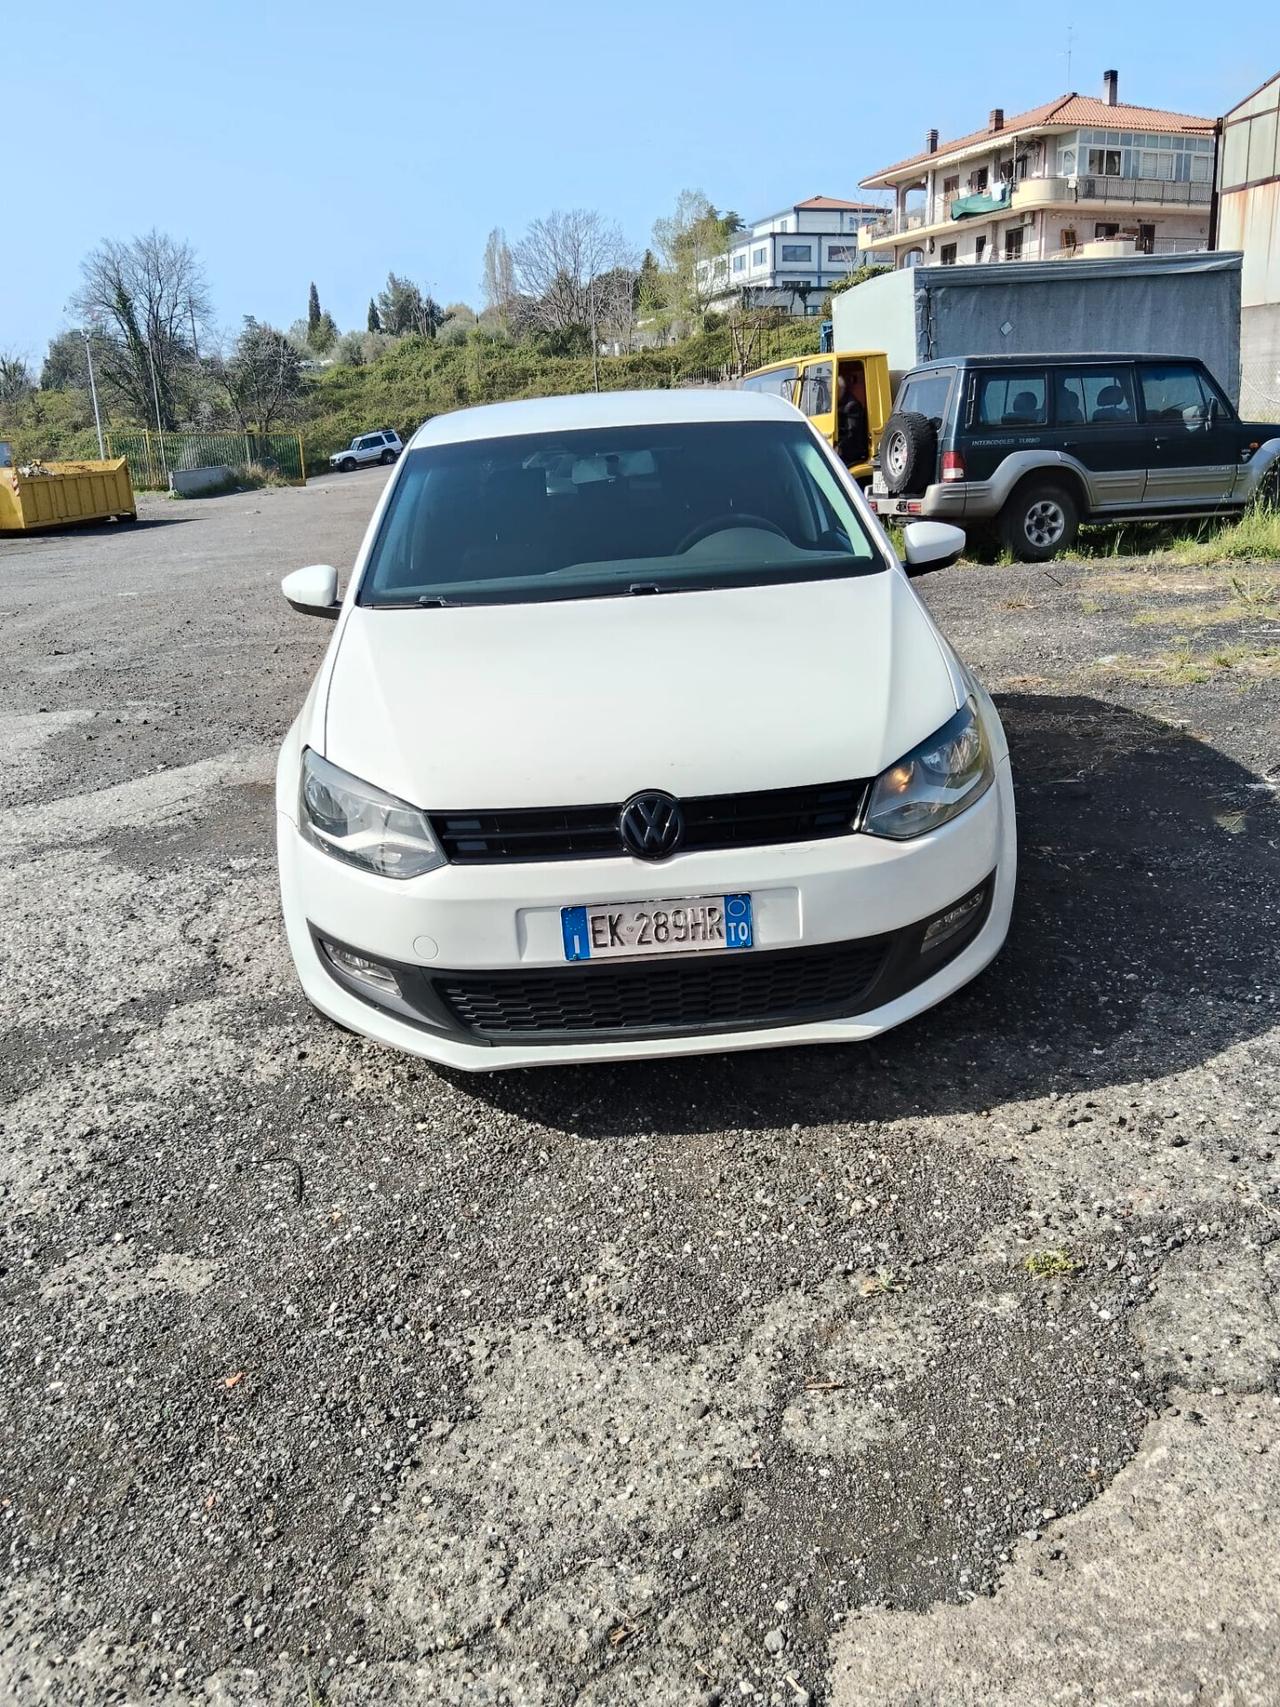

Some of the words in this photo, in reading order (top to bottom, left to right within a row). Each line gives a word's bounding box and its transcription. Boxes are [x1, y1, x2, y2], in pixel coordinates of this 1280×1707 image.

[623, 796, 678, 854] VW
[589, 913, 625, 949] EK
[635, 906, 724, 946] 289HR
[728, 921, 748, 942] TO
[574, 934, 580, 954] I
